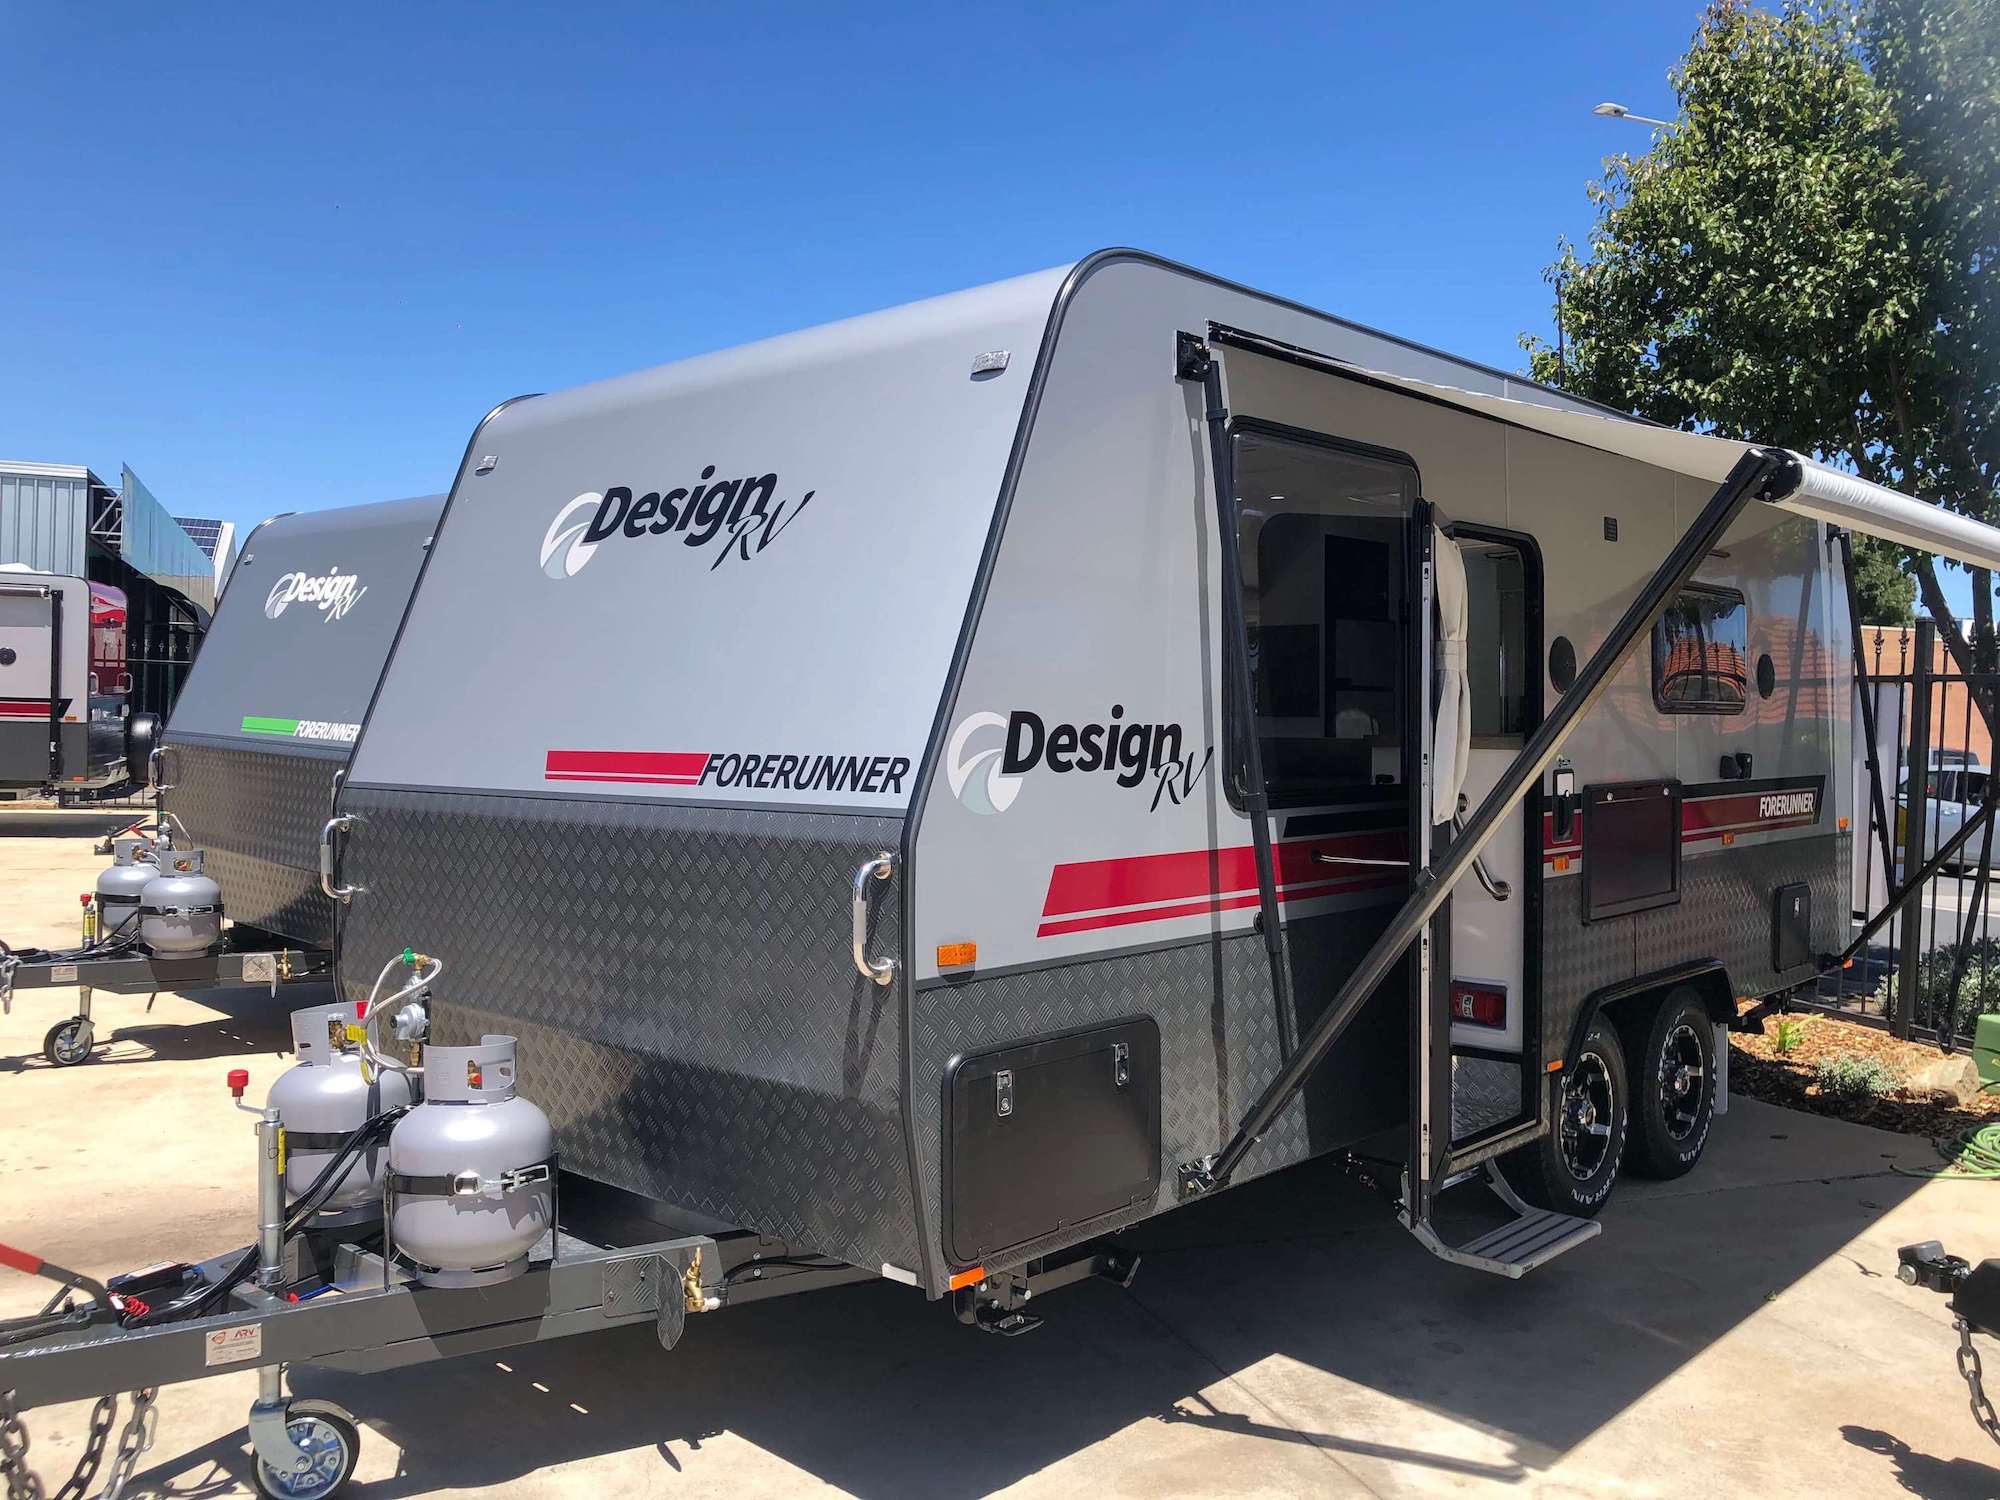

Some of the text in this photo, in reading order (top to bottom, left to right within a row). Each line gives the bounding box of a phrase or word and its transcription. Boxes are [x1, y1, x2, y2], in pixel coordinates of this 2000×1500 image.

[582, 465, 815, 571] Design RV
[282, 566, 368, 623] Design RV
[293, 720, 362, 742] FORERUNNER
[698, 753, 911, 793] FORERUNNER
[1001, 704, 1214, 813] Design RV
[1760, 793, 1814, 817] FORERUNNER
